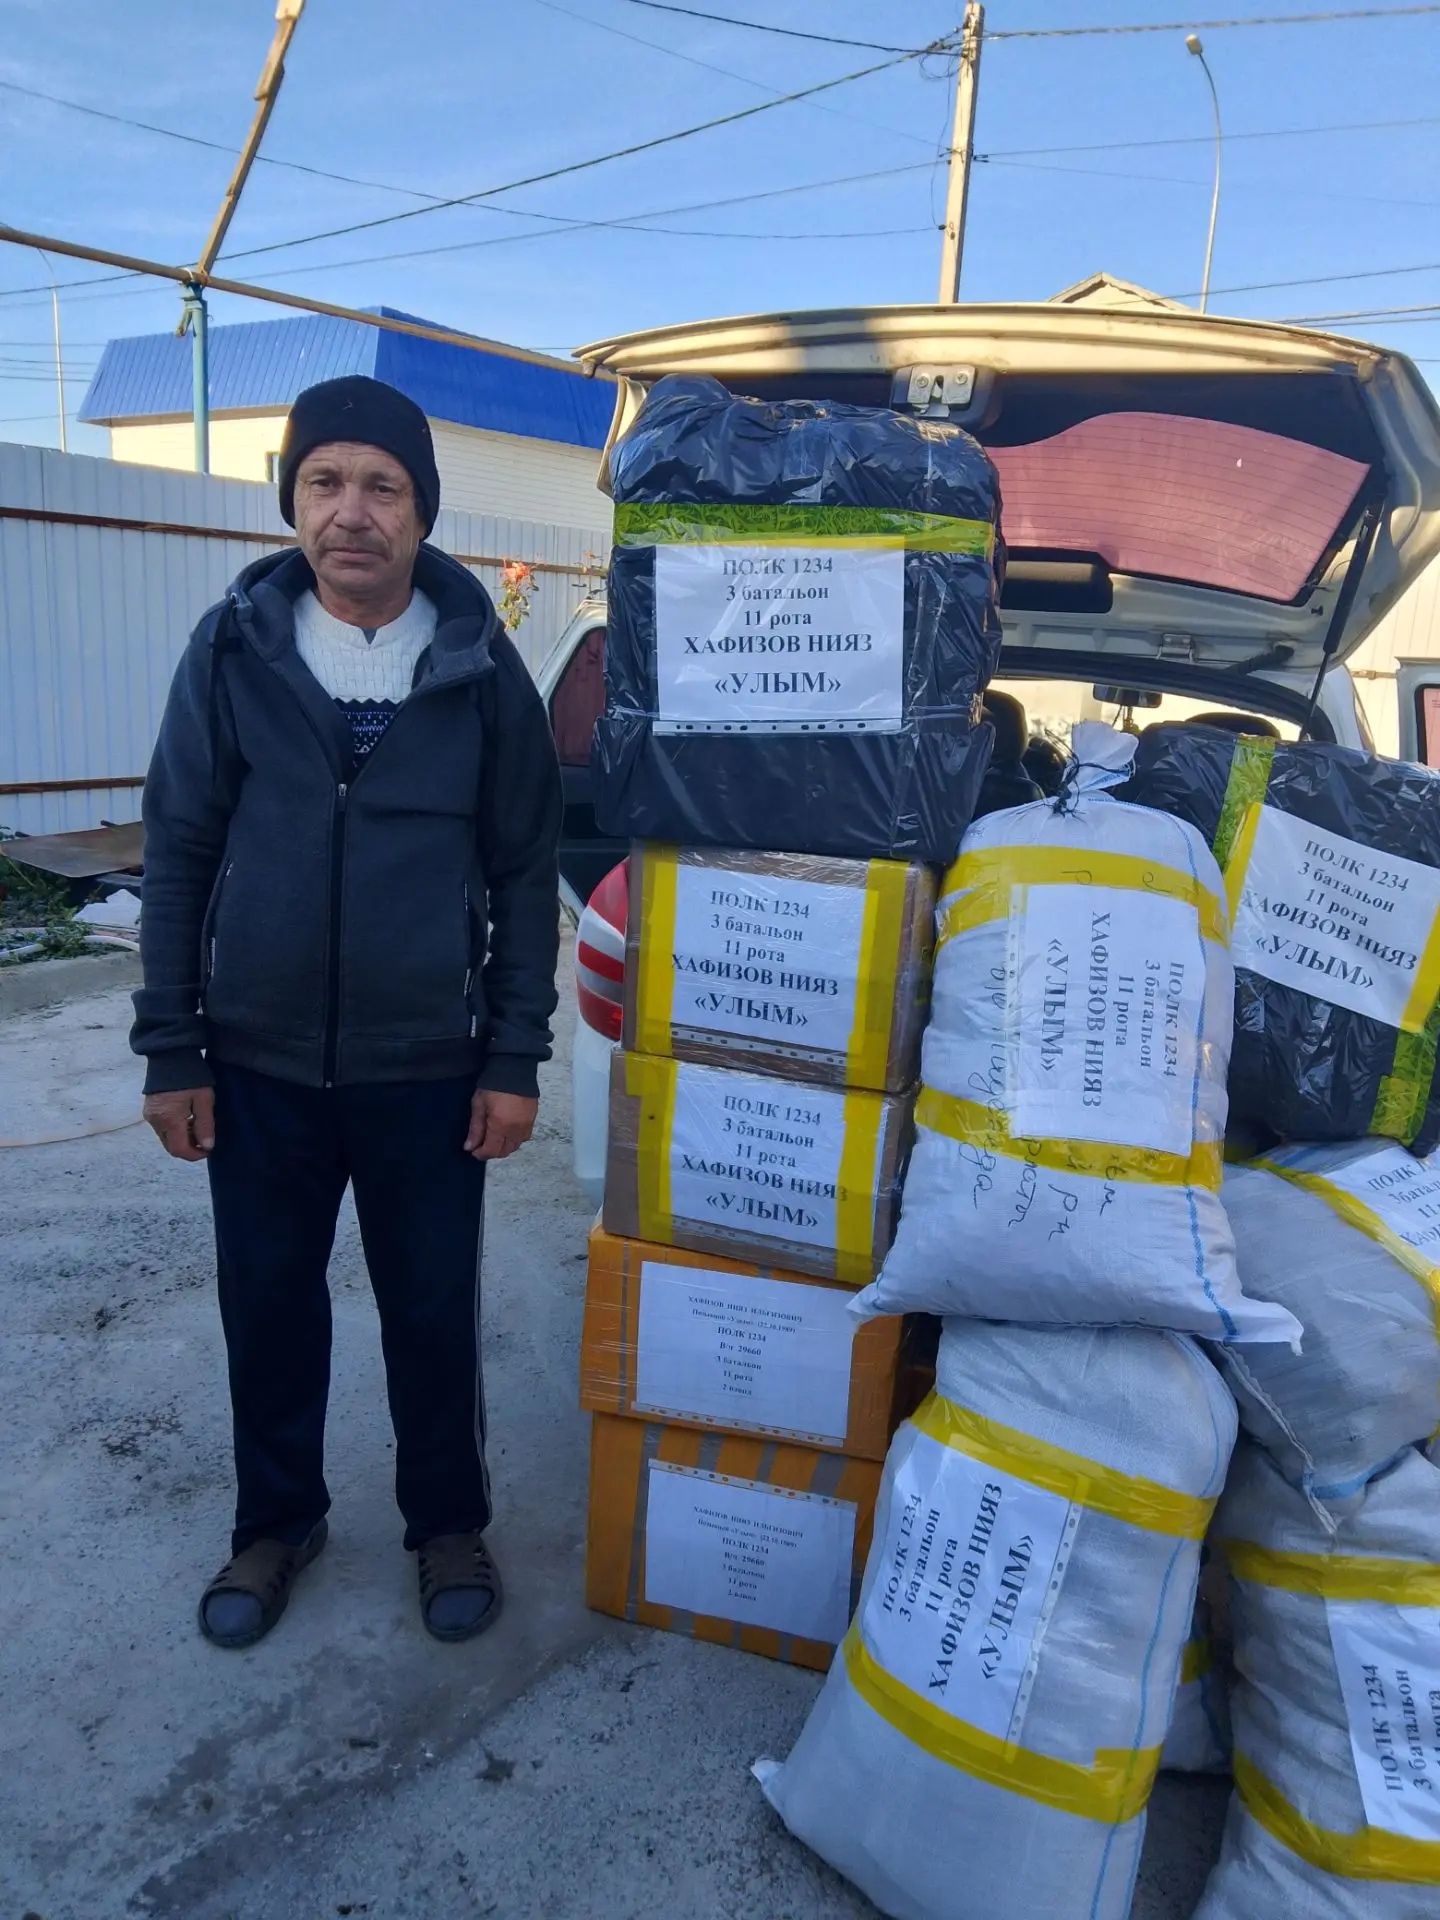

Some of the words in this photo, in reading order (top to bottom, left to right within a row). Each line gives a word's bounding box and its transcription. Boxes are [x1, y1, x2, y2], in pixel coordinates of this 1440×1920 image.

[722, 558, 786, 576] ПОЛК
[793, 557, 833, 574] 1234
[726, 585, 736, 601] 3
[742, 585, 829, 600] батальон
[744, 611, 761, 626] 11
[769, 612, 812, 629] рота
[684, 635, 801, 654] ХАФИЗОВ
[807, 633, 872, 653] НИЯЗ
[1304, 839, 1364, 876] ПОЛК
[1368, 868, 1410, 892] 1234
[710, 890, 768, 913] ПОЛК
[773, 900, 810, 919] 1234
[1298, 861, 1309, 875] 3
[1313, 868, 1395, 912] батальон
[1305, 888, 1324, 905] 11
[1327, 900, 1369, 926] рота
[710, 913, 720, 929] 3
[725, 914, 803, 941] батальон
[724, 940, 740, 955] 11
[746, 945, 785, 963] рота
[1144, 959, 1161, 971] 3
[1356, 933, 1418, 970] НИЯЗ
[672, 954, 773, 985] ХАФИЗОВ
[779, 971, 839, 996] НИЯЗ
[1085, 911, 1111, 1032] ХАФИЗОВ
[1119, 975, 1135, 996] 11
[1166, 962, 1185, 1031] ПОЛК
[1112, 1001, 1130, 1047] рота
[1140, 976, 1161, 1068] батальон
[1082, 1039, 1106, 1108] НИЯЗ
[1163, 1034, 1180, 1078] 1234
[723, 1095, 780, 1118] ПОЛК
[785, 1107, 821, 1126] 1234
[722, 1118, 732, 1132] 3
[737, 1118, 815, 1148] батальон
[736, 1143, 752, 1158] 11
[758, 1151, 797, 1168] рота
[681, 1154, 783, 1189] ХАФИЗОВ
[790, 1176, 847, 1201] НИЯЗ
[1368, 1164, 1417, 1191] ПОЛК
[717, 1326, 745, 1338] ПОЛК
[748, 1332, 767, 1342] 1234
[882, 1541, 909, 1613] ПОЛК
[900, 1493, 922, 1537] 1234
[905, 1508, 941, 1604] батальон
[925, 1590, 944, 1613] 11
[938, 1537, 959, 1589] рота
[929, 1559, 981, 1696] ХАФИЗОВ
[968, 1482, 1002, 1559] НИЯЗ
[899, 1606, 912, 1622] 3
[1361, 1663, 1388, 1710] 1234
[1396, 1669, 1427, 1772] батальон
[1372, 1718, 1404, 1792] ПОЛК
[1413, 1777, 1432, 1791] 3
